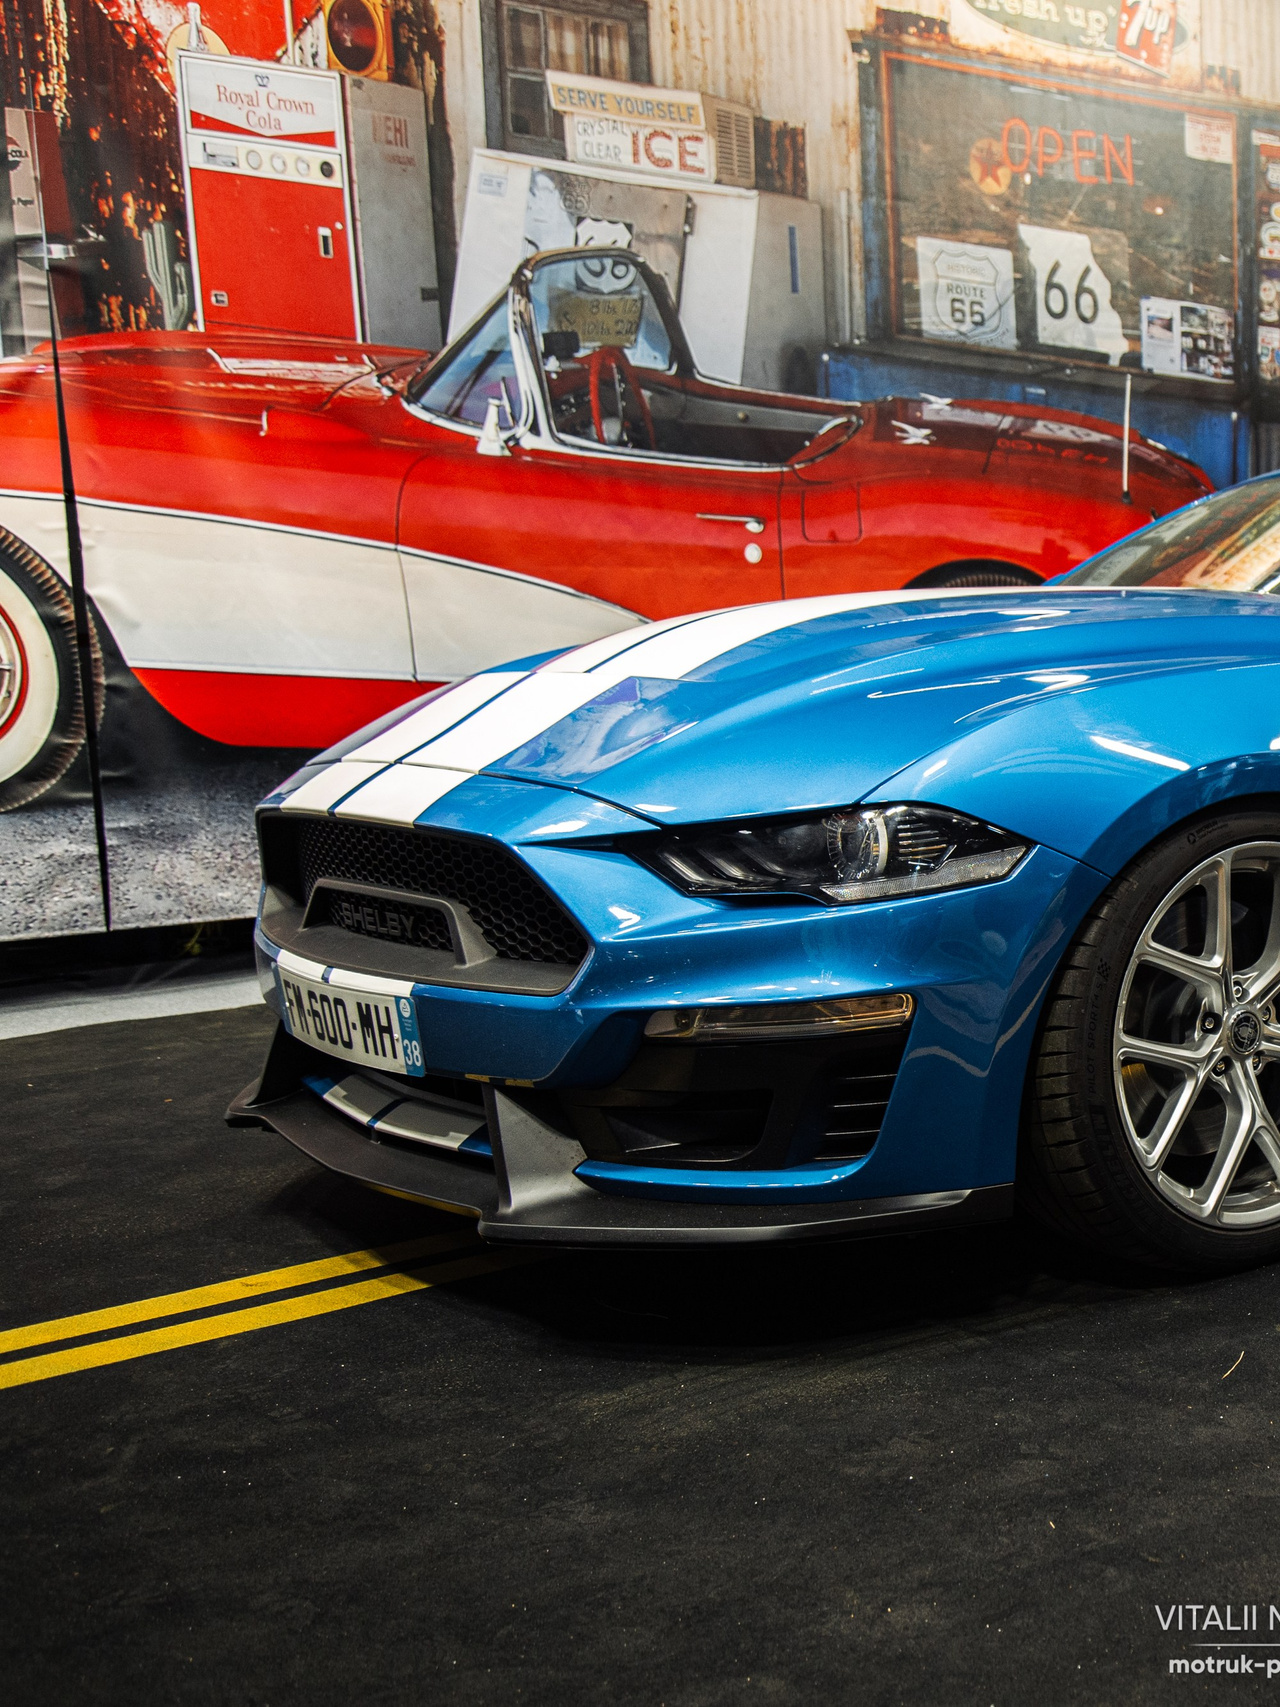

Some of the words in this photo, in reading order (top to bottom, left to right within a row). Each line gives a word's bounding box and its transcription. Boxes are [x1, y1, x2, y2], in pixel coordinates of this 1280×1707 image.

[216, 84, 260, 111] Royal
[267, 94, 316, 116] Crown
[557, 86, 609, 112] SERVE
[614, 95, 695, 123] YOURSELF
[246, 110, 283, 131] Cola
[576, 117, 628, 138] CRYSTAL
[583, 141, 622, 163] CLEAR
[631, 130, 705, 175] ICE
[1002, 117, 1135, 186] OPEN
[946, 283, 986, 299] ROUTE
[1044, 259, 1099, 325] 66
[951, 298, 986, 327] 66
[341, 903, 415, 939] SHELBY
[283, 978, 398, 1060] FM-600-MH
[403, 1038, 422, 1067] 38
